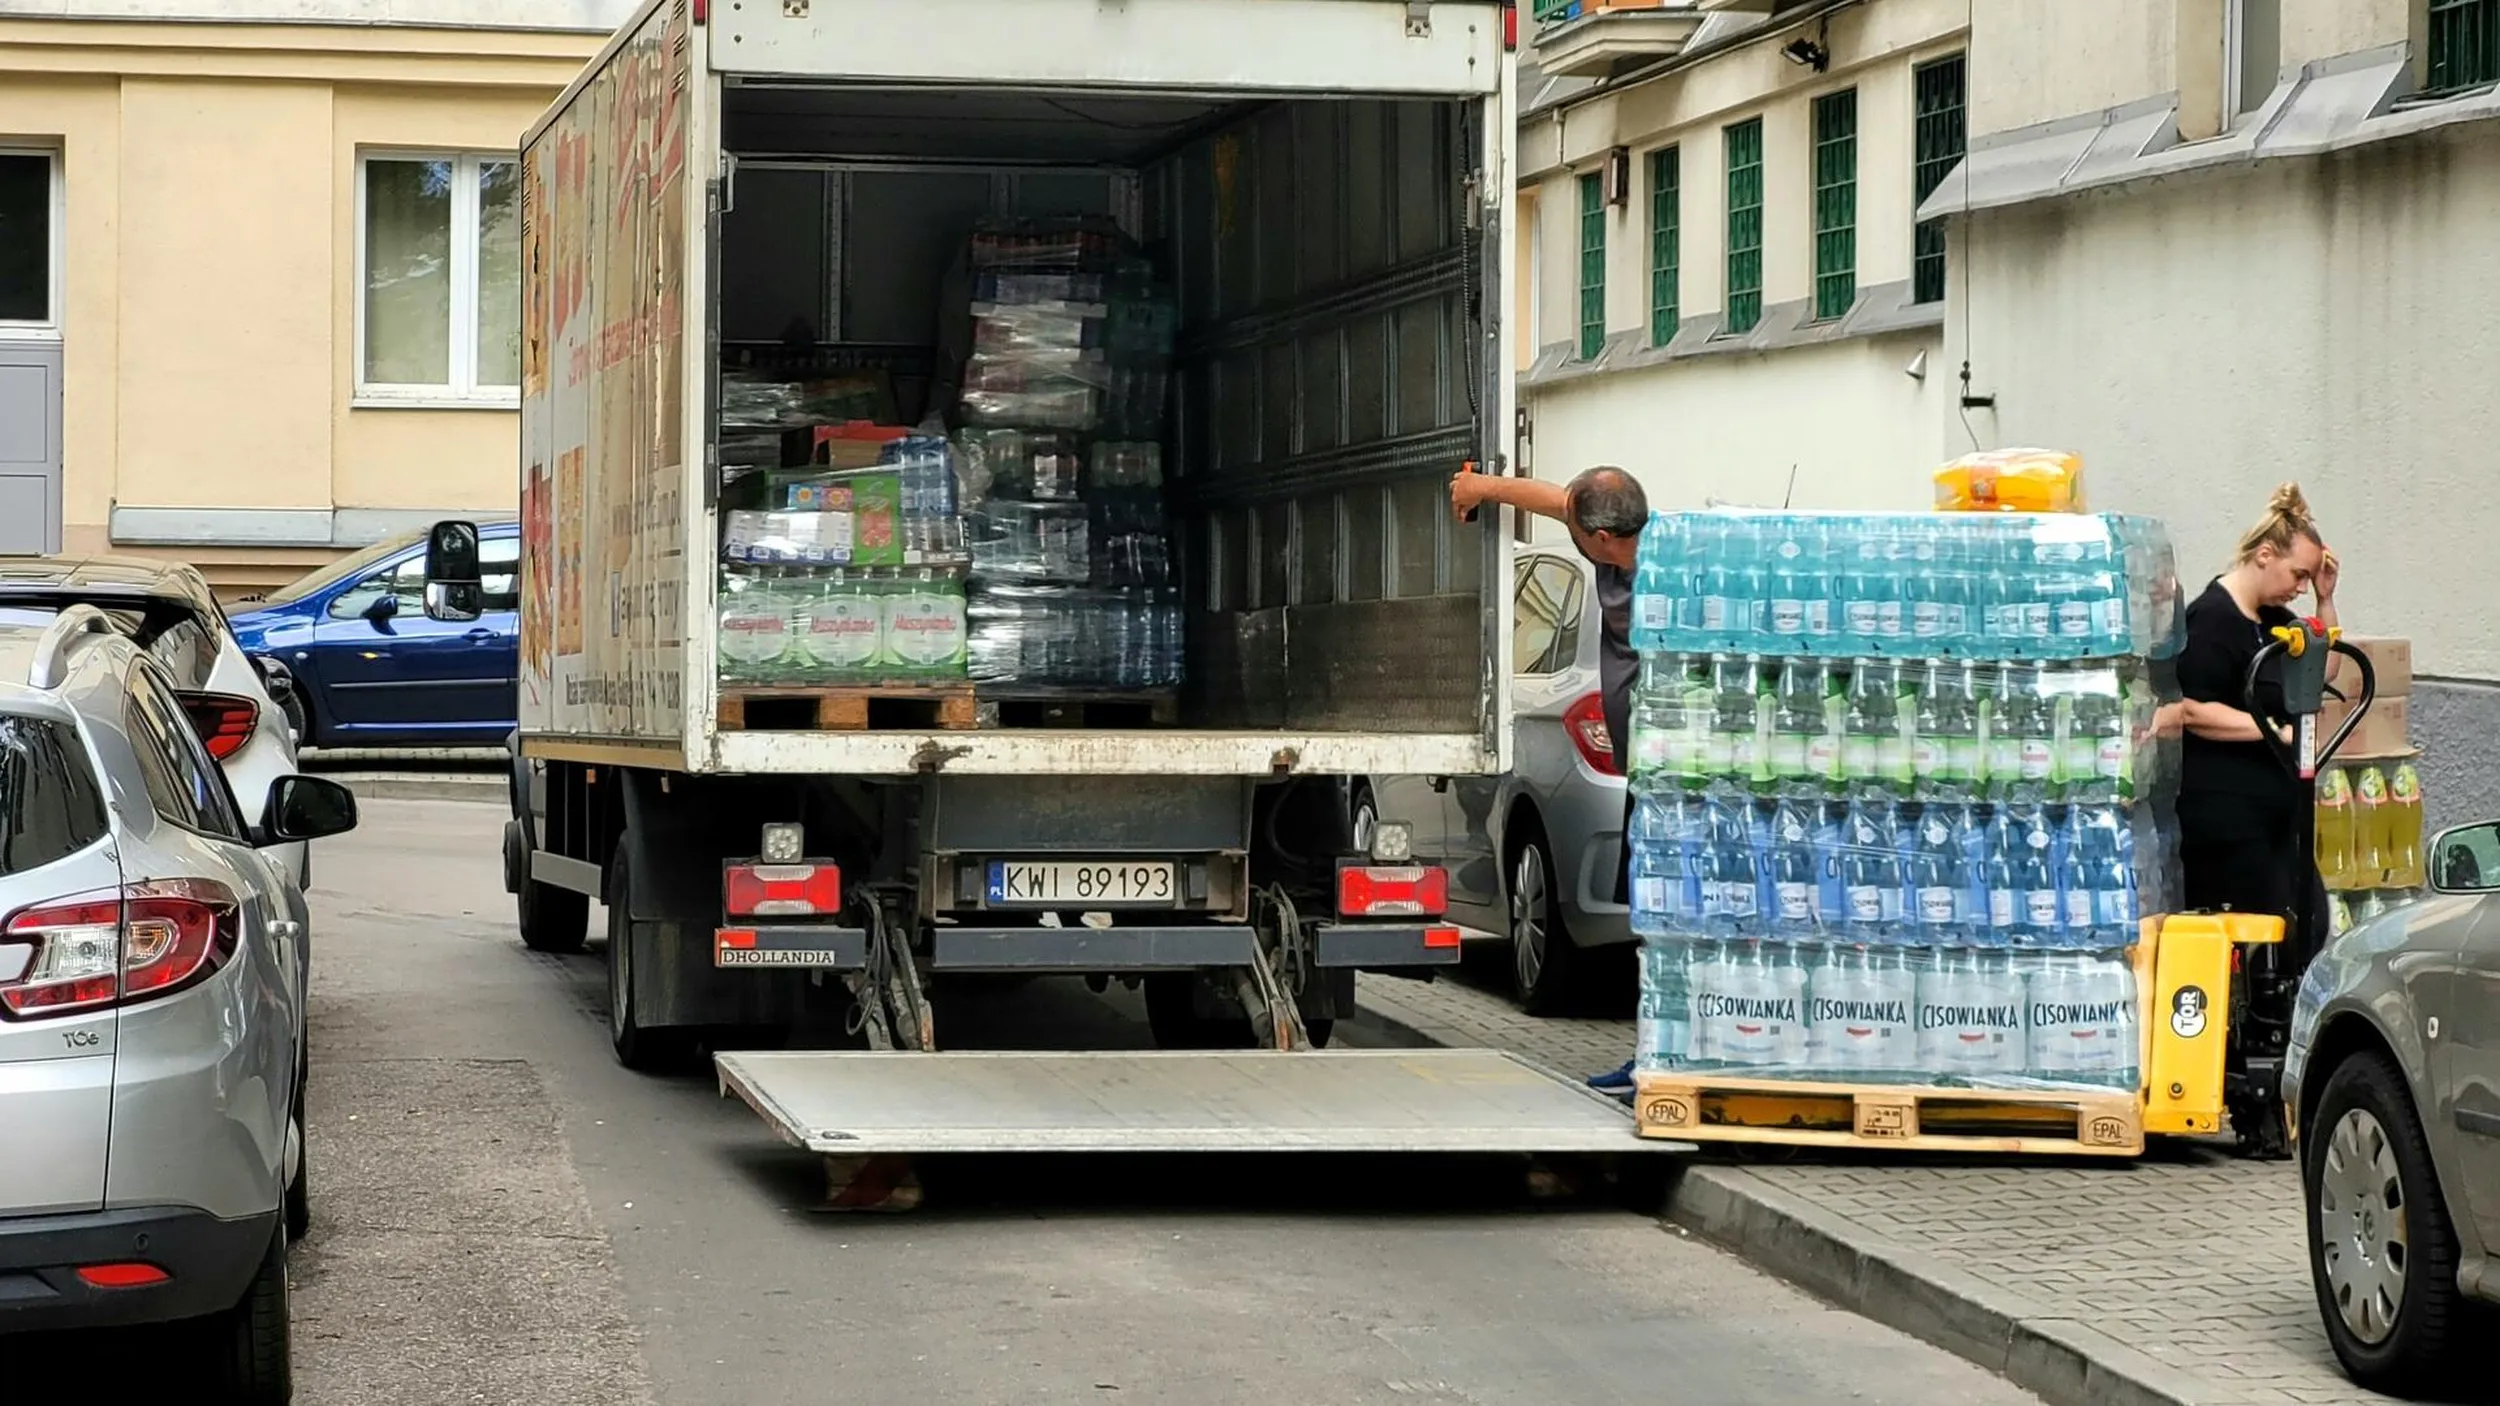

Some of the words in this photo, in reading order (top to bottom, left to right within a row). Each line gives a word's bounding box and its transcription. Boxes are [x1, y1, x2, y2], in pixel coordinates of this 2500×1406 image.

[990, 886, 1003, 896] PL
[1007, 867, 1058, 897] KWI
[1077, 867, 1169, 897] 89193
[723, 951, 832, 963] DHOLLANDIA
[1812, 997, 1907, 1024] CISOWIANKA
[1922, 1004, 2019, 1028] CISOWIANKA
[2180, 991, 2197, 1029] TOR
[1649, 1102, 1682, 1120] EPAL
[2093, 1122, 2122, 1139] EPAL
